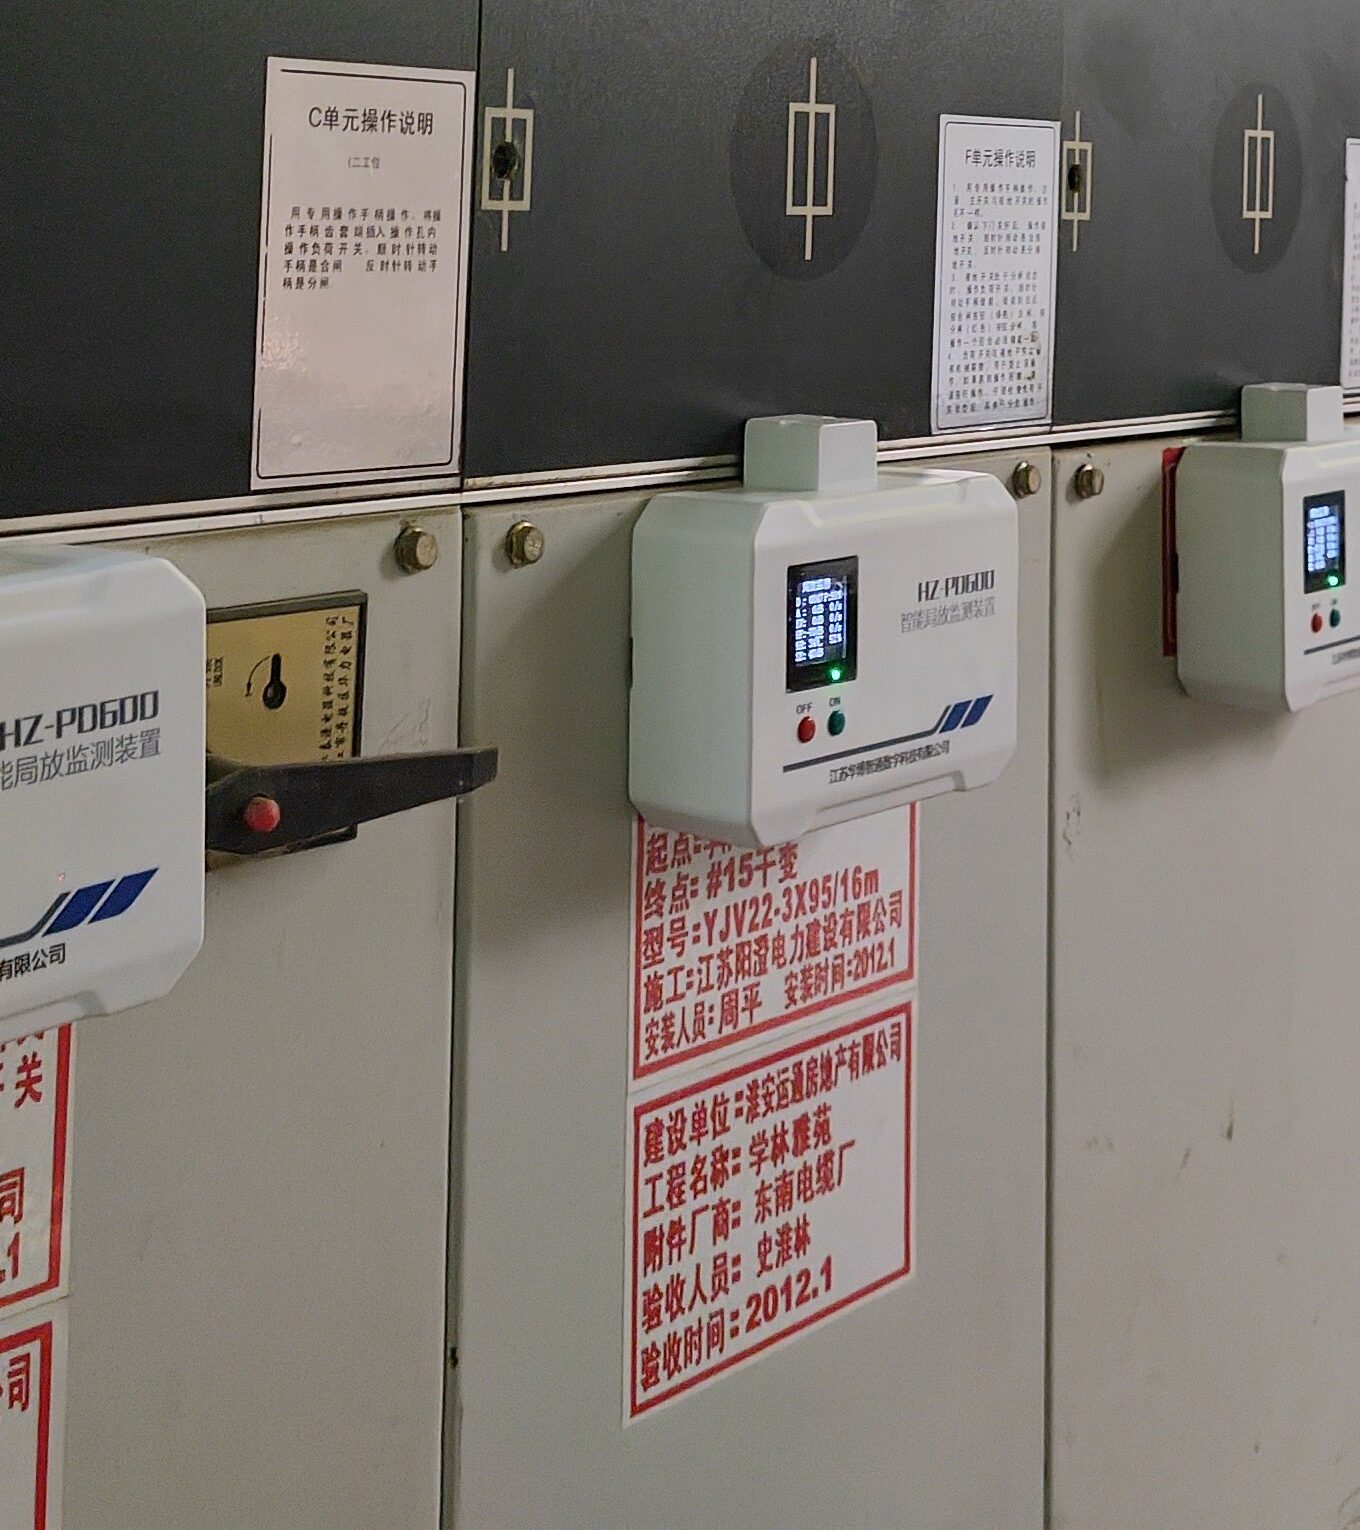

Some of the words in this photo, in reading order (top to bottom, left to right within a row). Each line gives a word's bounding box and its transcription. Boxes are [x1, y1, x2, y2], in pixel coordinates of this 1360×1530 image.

[308, 106, 433, 135] C单元操作说明
[965, 148, 1036, 168] F单元操作说明
[918, 570, 994, 602] HZ-PD600
[796, 701, 813, 715] OFF
